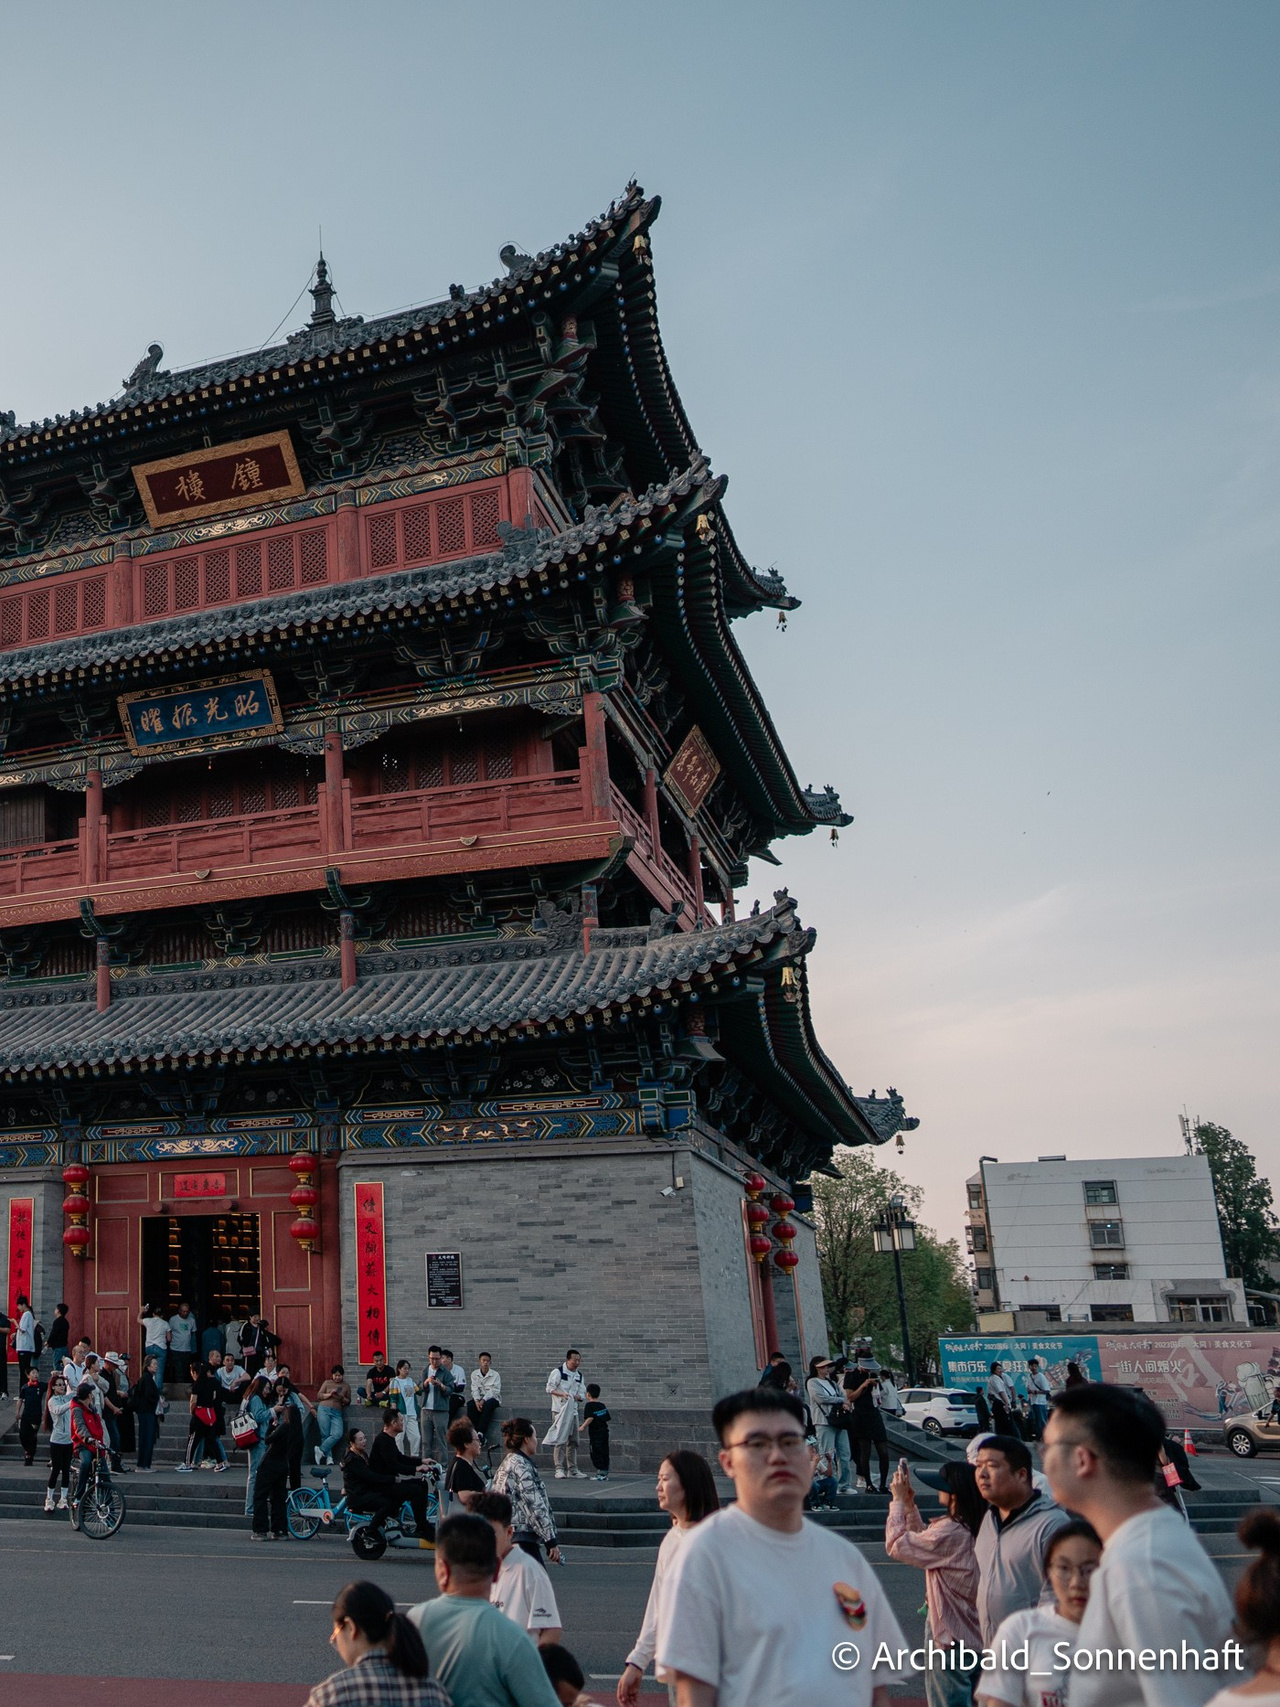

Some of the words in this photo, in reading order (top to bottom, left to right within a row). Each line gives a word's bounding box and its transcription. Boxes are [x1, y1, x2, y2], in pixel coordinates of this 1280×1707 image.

[948, 1361, 987, 1373] 集市行乐
[1108, 1360, 1183, 1373] 一街人间烟火
